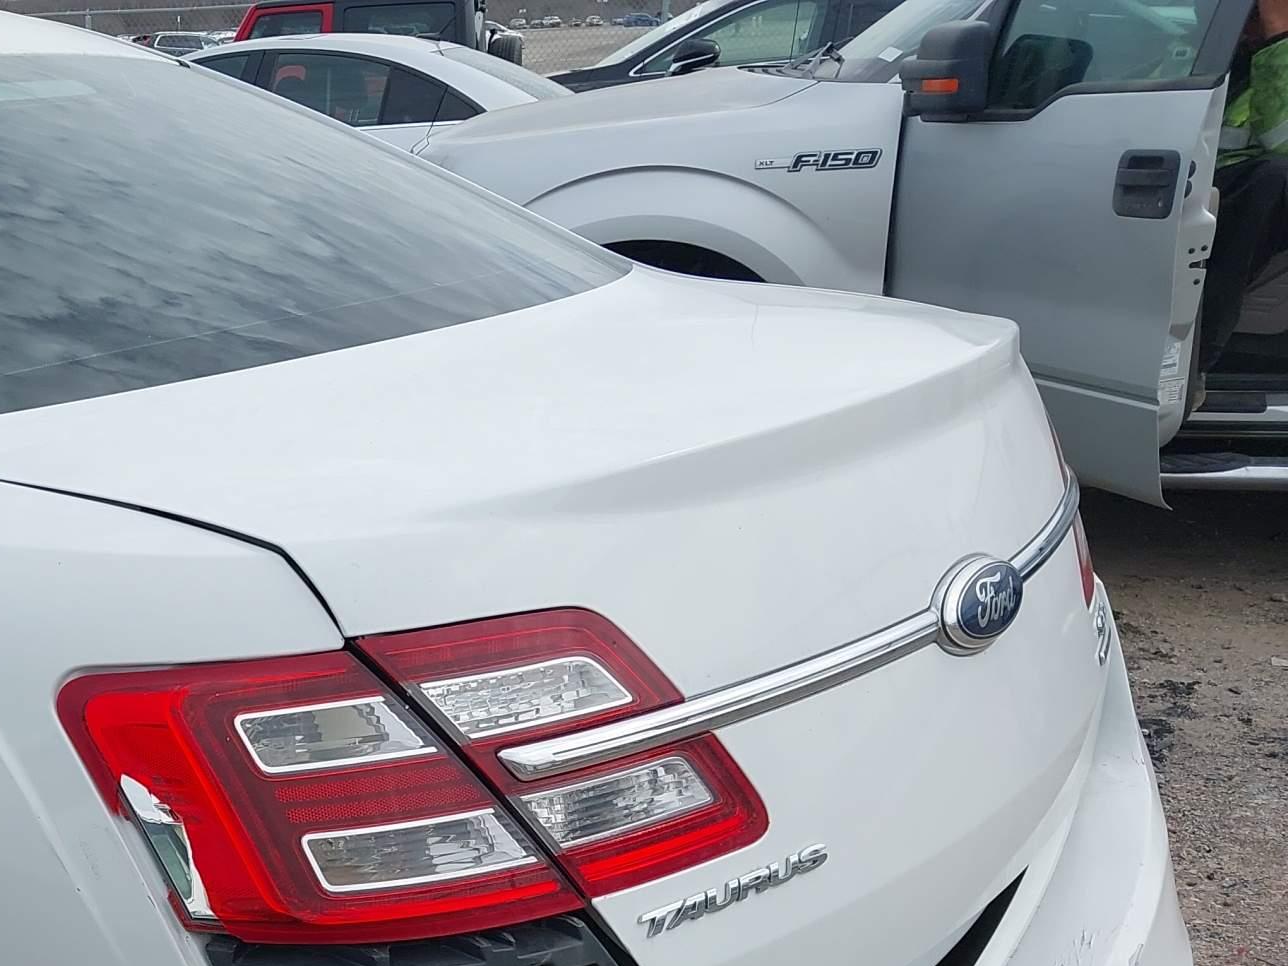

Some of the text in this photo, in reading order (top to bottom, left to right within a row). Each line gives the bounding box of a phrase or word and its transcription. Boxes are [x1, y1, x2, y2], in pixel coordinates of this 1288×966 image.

[789, 149, 881, 171] F-150
[976, 572, 1016, 628] Ford
[637, 843, 829, 938] TAURUS
